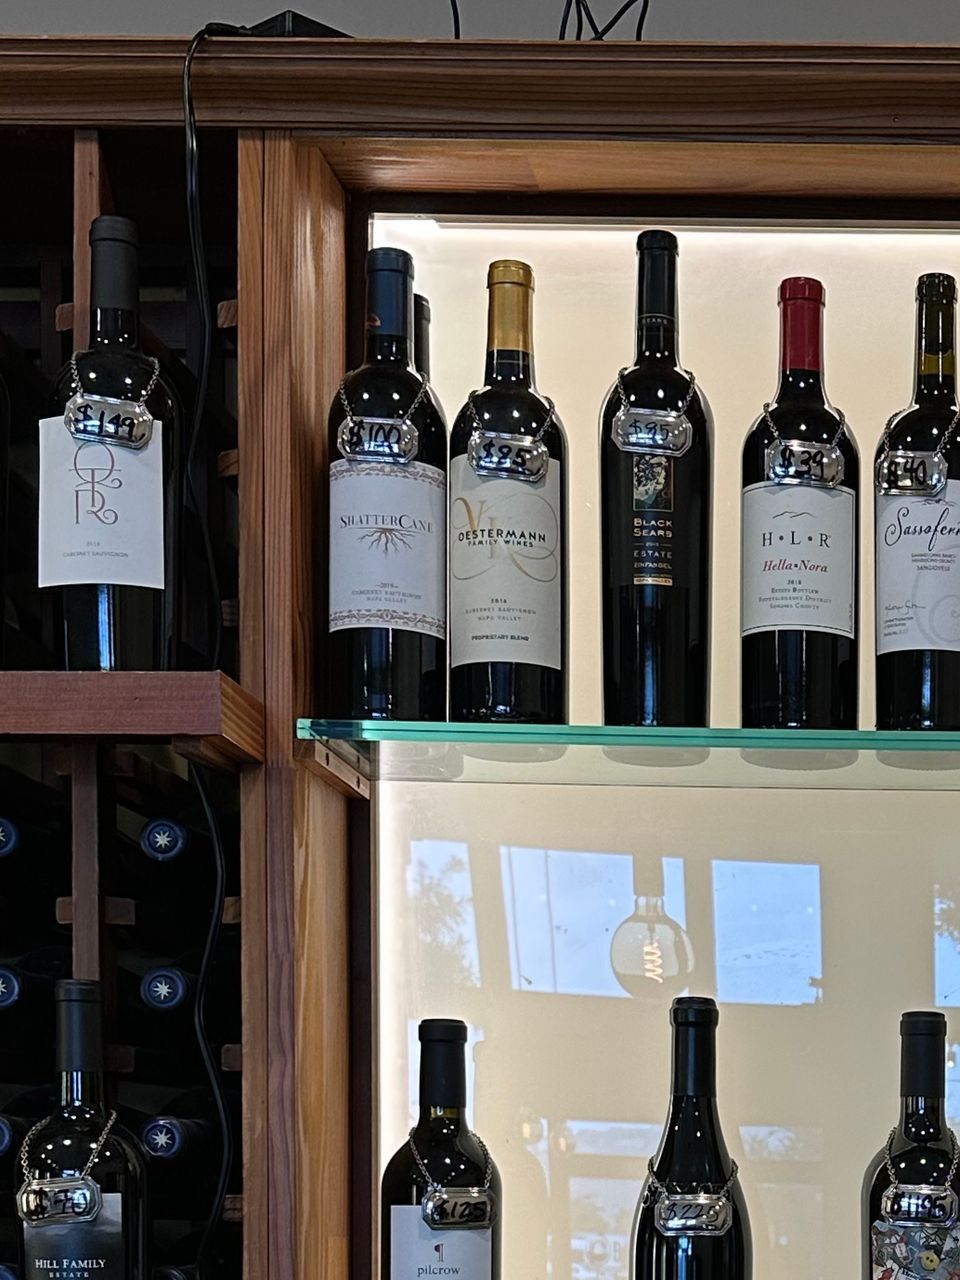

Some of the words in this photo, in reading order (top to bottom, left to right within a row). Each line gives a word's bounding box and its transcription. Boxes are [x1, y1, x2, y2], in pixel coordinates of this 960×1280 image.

[780, 448, 825, 480] $39
[633, 518, 673, 527] BLACK
[458, 528, 547, 543] OESTERMANN
[633, 528, 673, 538] SEARS
[468, 540, 499, 548] FAMILY
[503, 540, 534, 548] WINES
[633, 550, 673, 559] ESTATE
[665, 1202, 719, 1221] $225
[34, 1259, 60, 1269] HILL
[63, 1258, 107, 1269] FAMILY
[417, 1264, 461, 1278] pilcrow
